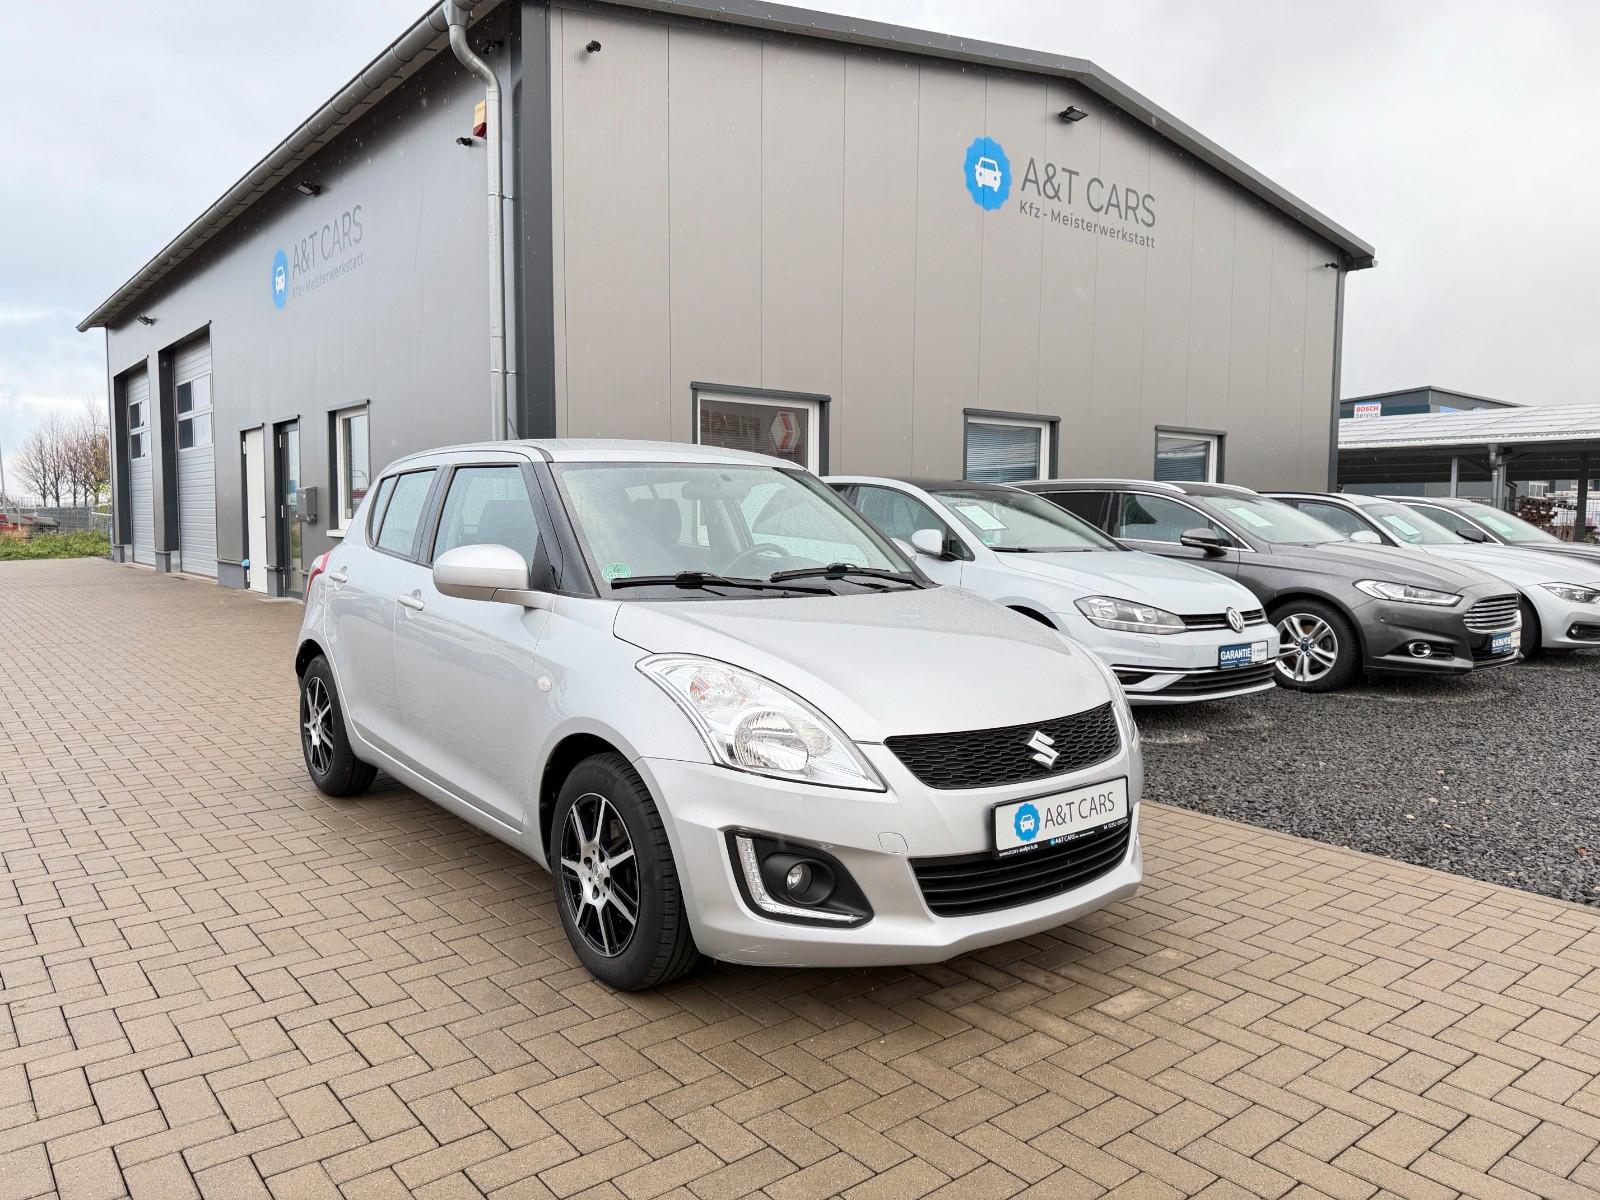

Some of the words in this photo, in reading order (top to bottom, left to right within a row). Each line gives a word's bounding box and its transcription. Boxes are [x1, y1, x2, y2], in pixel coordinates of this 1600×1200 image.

[1020, 157, 1080, 205] A&T
[1086, 177, 1156, 228] CARS
[292, 231, 318, 280] A&T
[321, 204, 363, 261] CARS
[1356, 405, 1379, 413] BOSCH
[1220, 648, 1252, 661] GARANTIE
[1044, 801, 1075, 829] A&T
[1078, 791, 1115, 819] CARS
[1064, 833, 1076, 842] CARS
